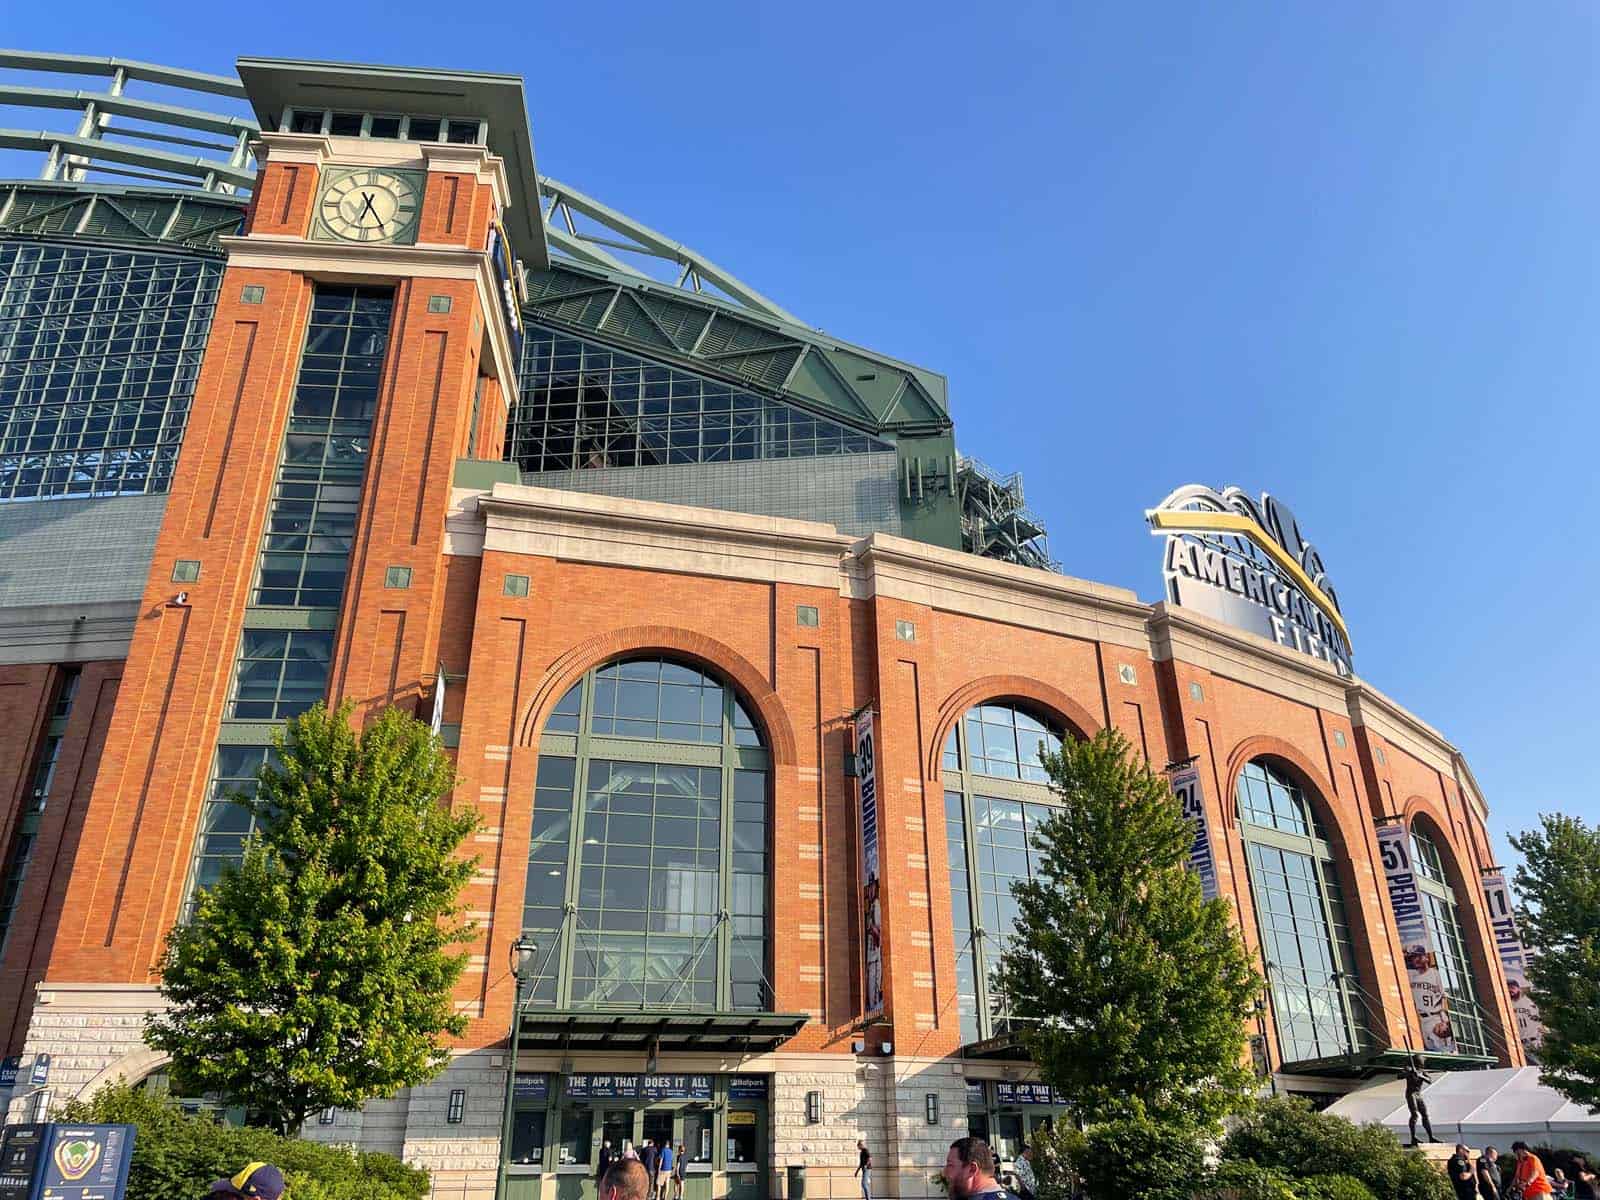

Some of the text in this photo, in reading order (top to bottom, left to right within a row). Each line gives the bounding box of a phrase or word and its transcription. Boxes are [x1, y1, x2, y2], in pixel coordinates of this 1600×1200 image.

[1166, 535, 1317, 634] AMERICAN
[1270, 615, 1347, 676] FIELD
[860, 733, 873, 779] 39
[1176, 784, 1202, 818] 24
[862, 777, 877, 874] BURNES
[1379, 839, 1409, 871] 51
[1386, 872, 1426, 944] PERALTA
[568, 1077, 709, 1088] THE APP THAT DOES IT ALL
[998, 1084, 1013, 1094] THE
[1016, 1085, 1030, 1095] APP
[1031, 1085, 1050, 1096] THAT
